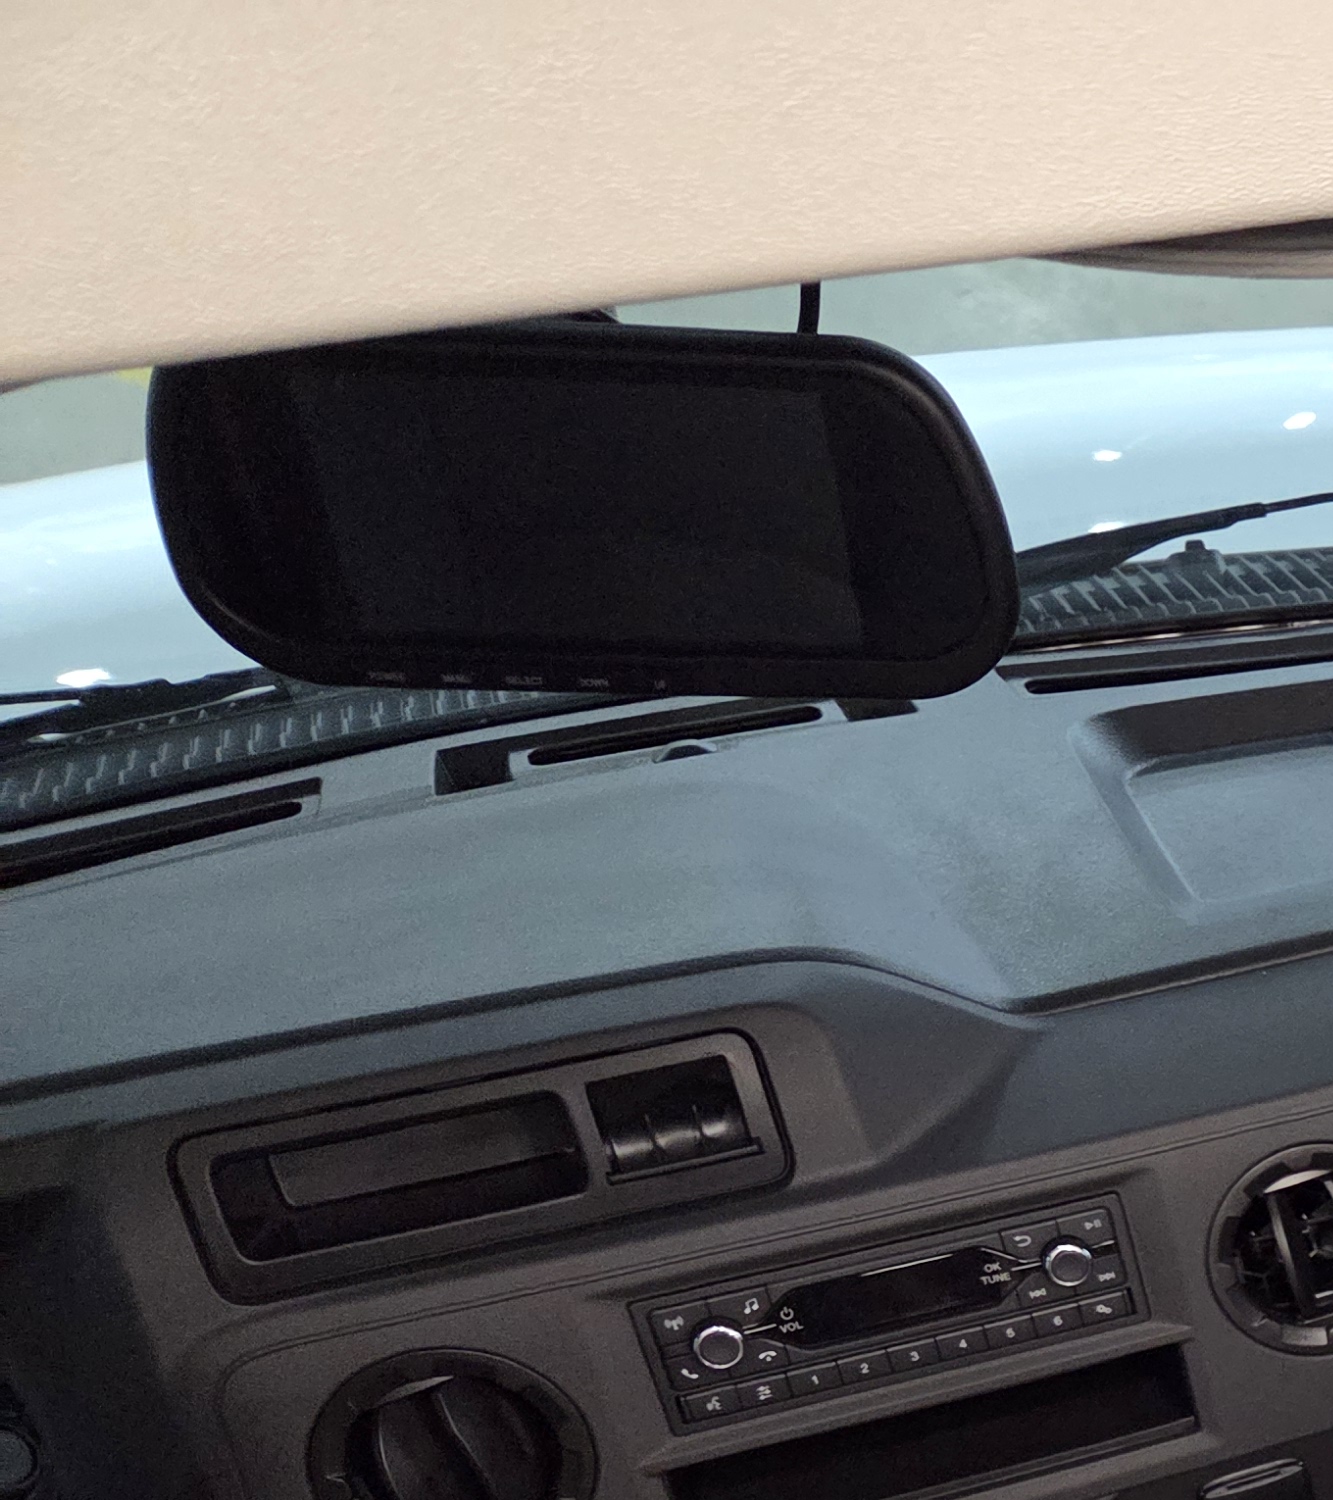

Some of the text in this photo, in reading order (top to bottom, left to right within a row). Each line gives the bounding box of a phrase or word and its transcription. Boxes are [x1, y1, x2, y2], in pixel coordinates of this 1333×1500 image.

[983, 1262, 1002, 1273] OK
[980, 1272, 1011, 1285] TUNE
[1053, 1315, 1063, 1326] 6
[779, 1321, 804, 1333] VOL
[959, 1338, 968, 1348] 4
[909, 1350, 920, 1362] 3
[860, 1362, 870, 1374] 2
[811, 1374, 819, 1385] 1
